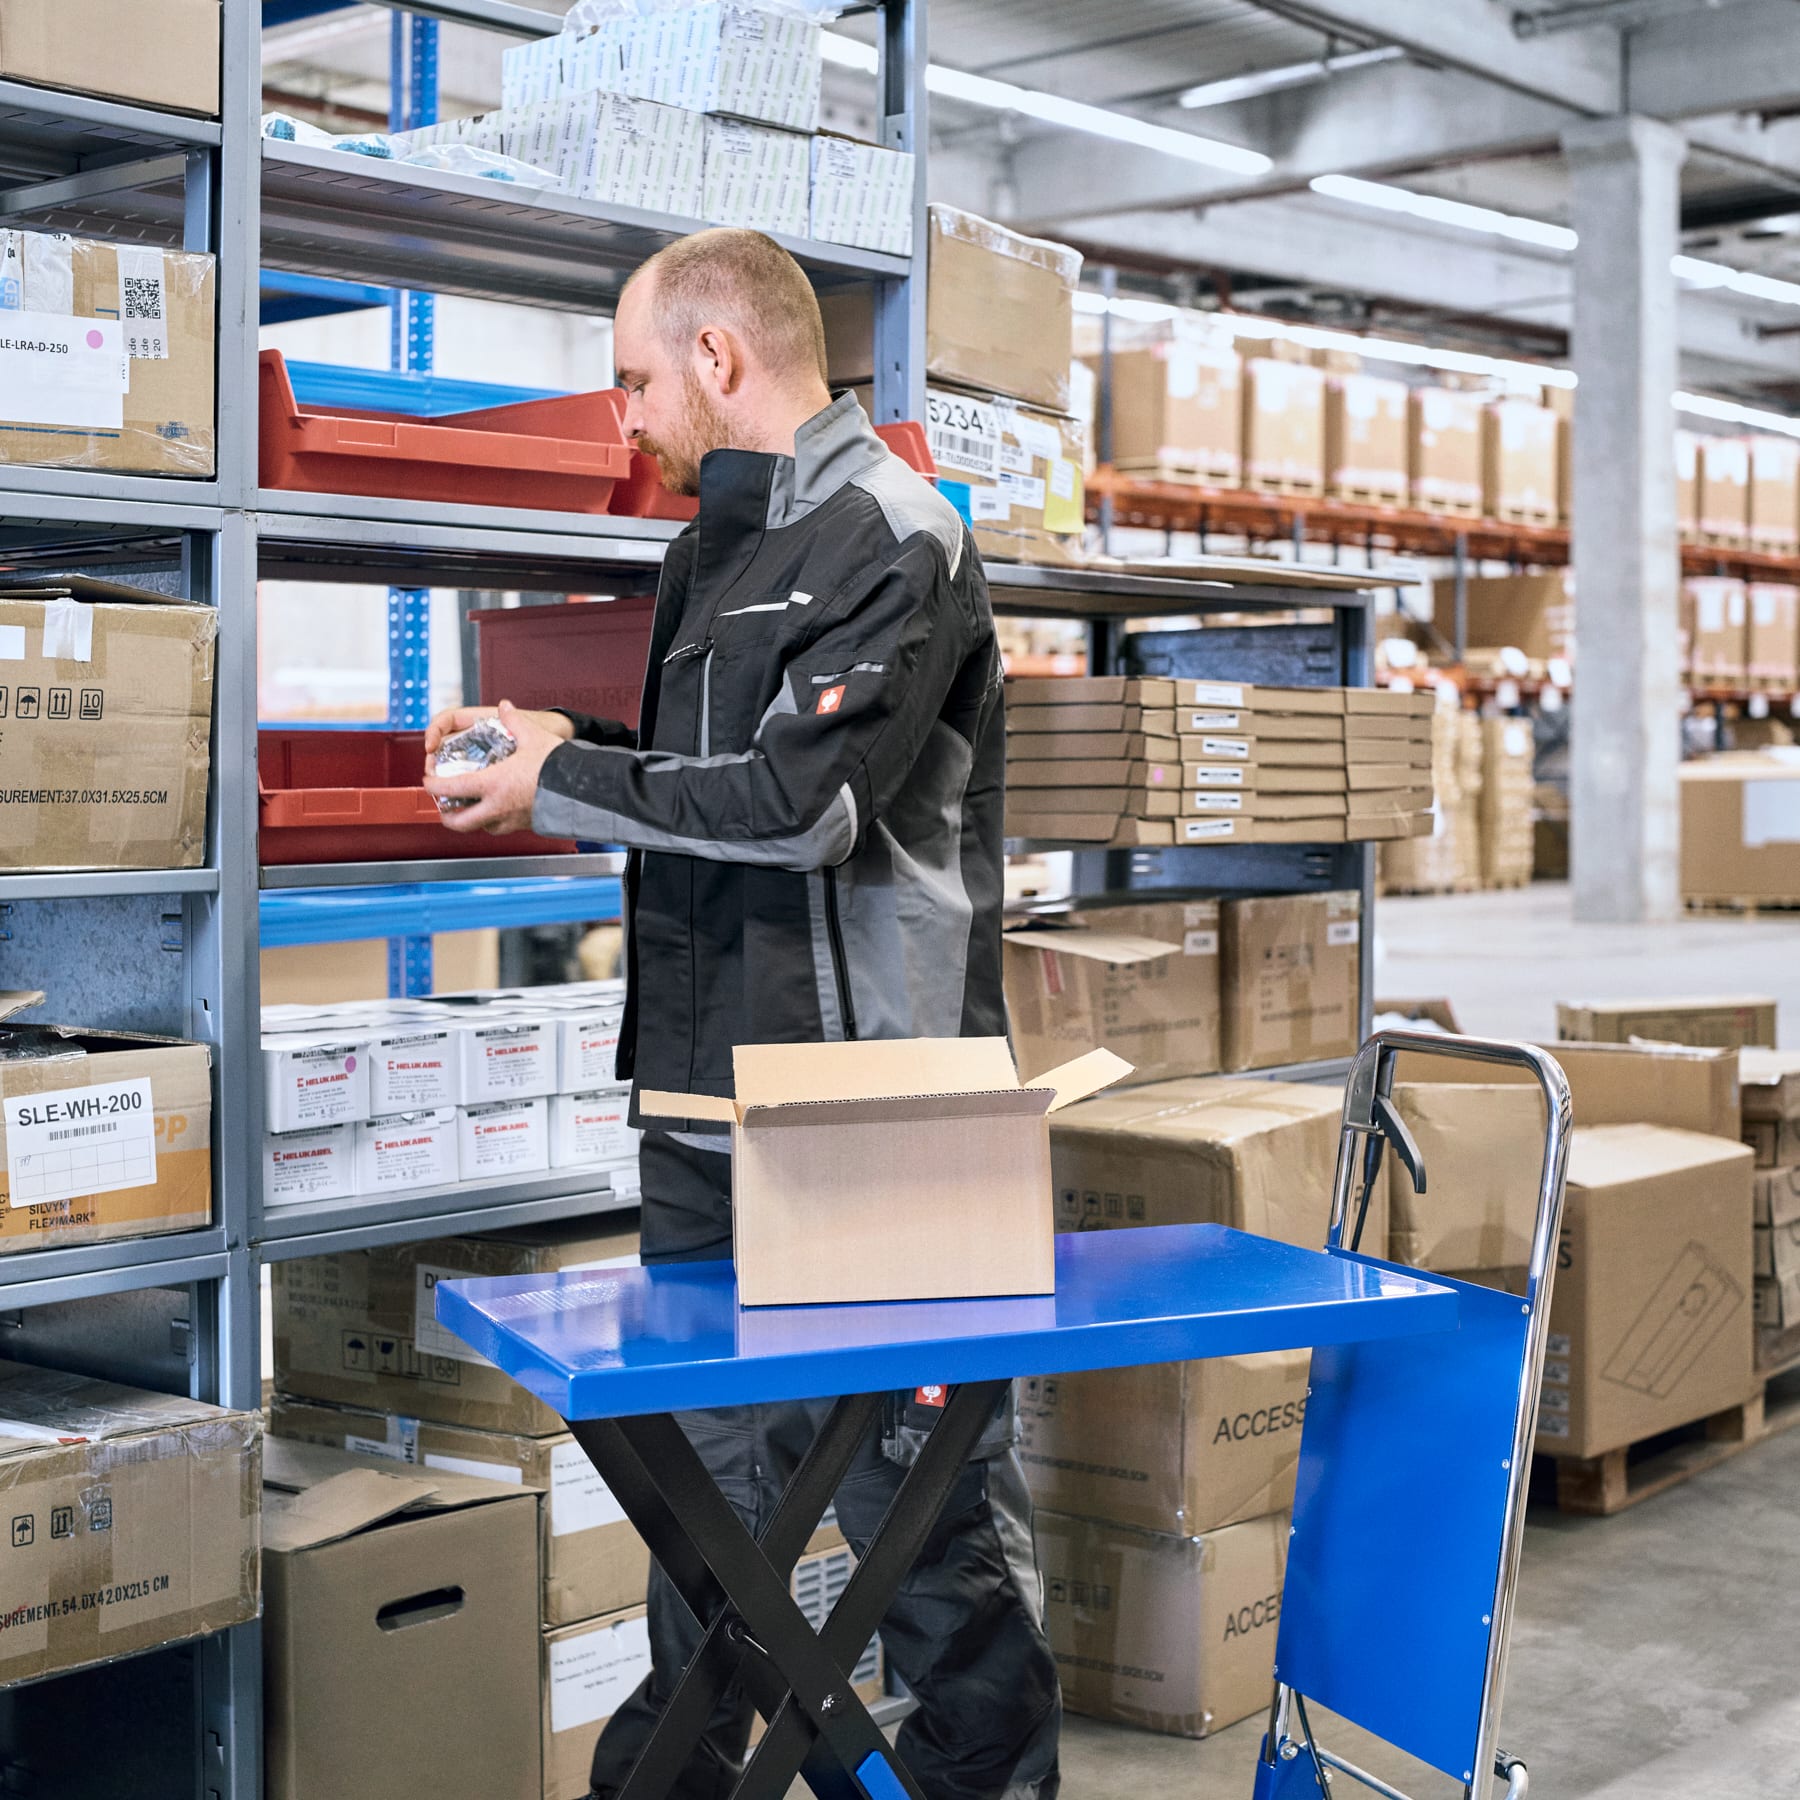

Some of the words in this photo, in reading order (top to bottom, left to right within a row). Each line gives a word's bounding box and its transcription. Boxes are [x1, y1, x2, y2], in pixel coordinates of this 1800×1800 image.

[84, 694, 100, 708] 10
[494, 1044, 539, 1056] HELUKABEL
[396, 1061, 443, 1070] HELUKABEL
[305, 1073, 349, 1087] HELUKABEL
[18, 1091, 142, 1127] SLE-WH-200
[483, 1122, 529, 1134] HELUKABEL
[384, 1136, 433, 1150] HELUKABEL
[282, 1148, 333, 1160] HELUKABEL
